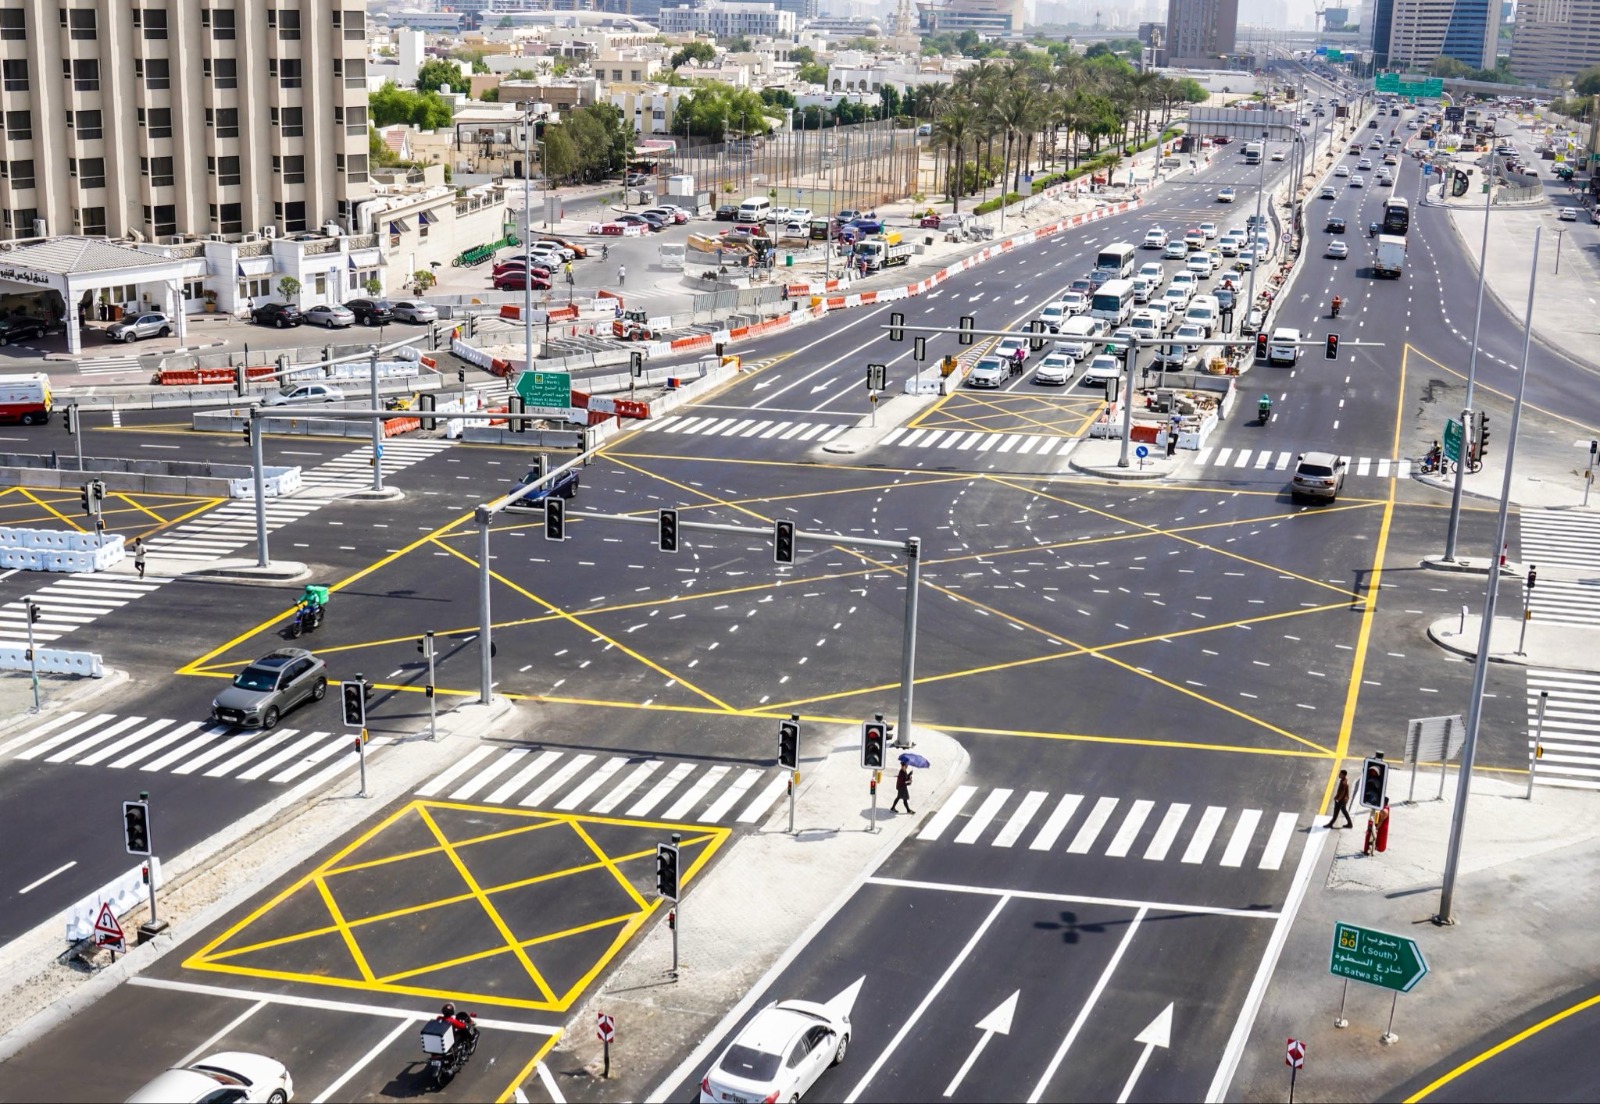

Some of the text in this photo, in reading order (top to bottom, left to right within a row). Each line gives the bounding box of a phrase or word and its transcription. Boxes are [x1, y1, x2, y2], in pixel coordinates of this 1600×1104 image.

[33, 273, 49, 283] فندق
[1341, 937, 1355, 948] 90
[1334, 951, 1403, 975] شارع السطوة
[1332, 964, 1383, 982] Al Satwa St
